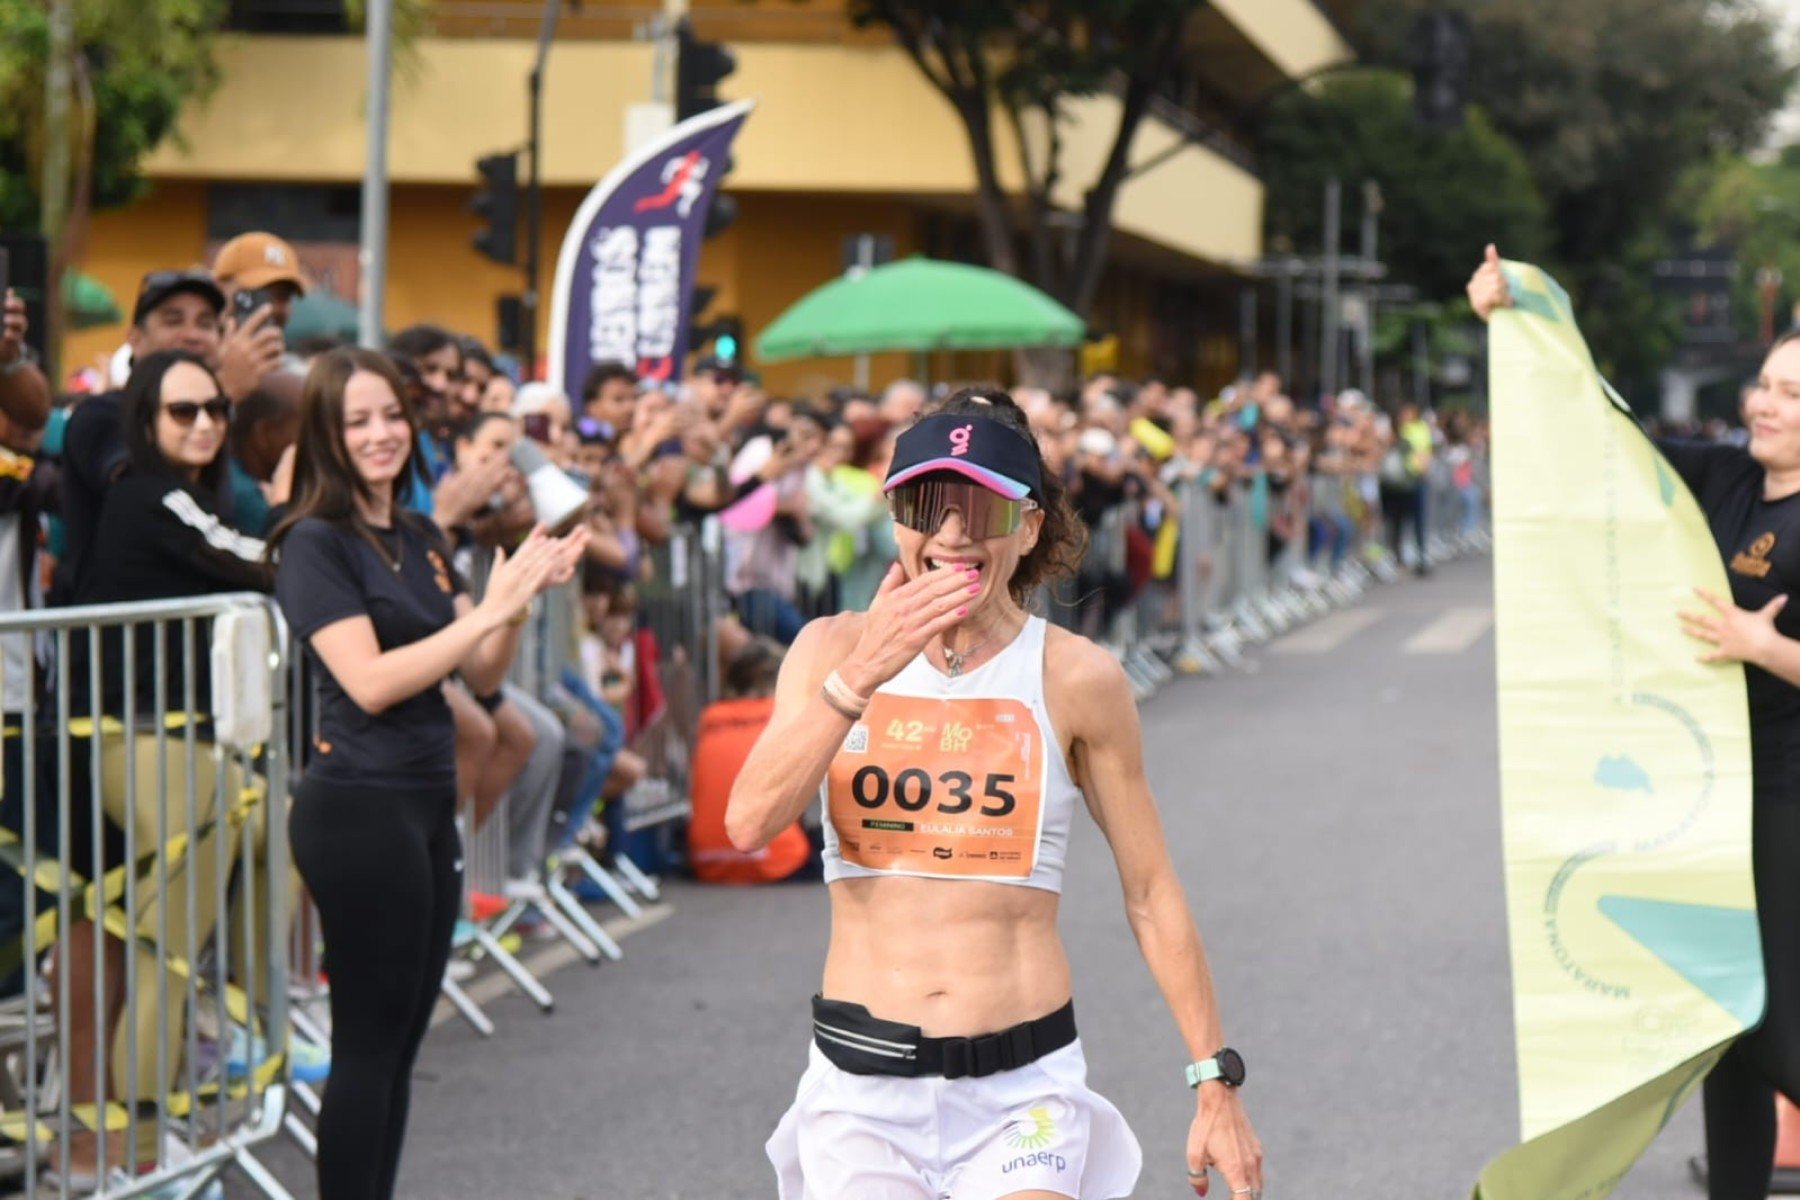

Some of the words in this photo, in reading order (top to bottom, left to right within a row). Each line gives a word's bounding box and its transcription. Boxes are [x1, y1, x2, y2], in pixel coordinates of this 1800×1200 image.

[886, 719, 924, 742] 42
[852, 765, 1016, 817] 0035
[968, 826, 1014, 837] SANTOS
[1543, 916, 1631, 1000] MARATONA
[1002, 1151, 1066, 1173] unaerp
